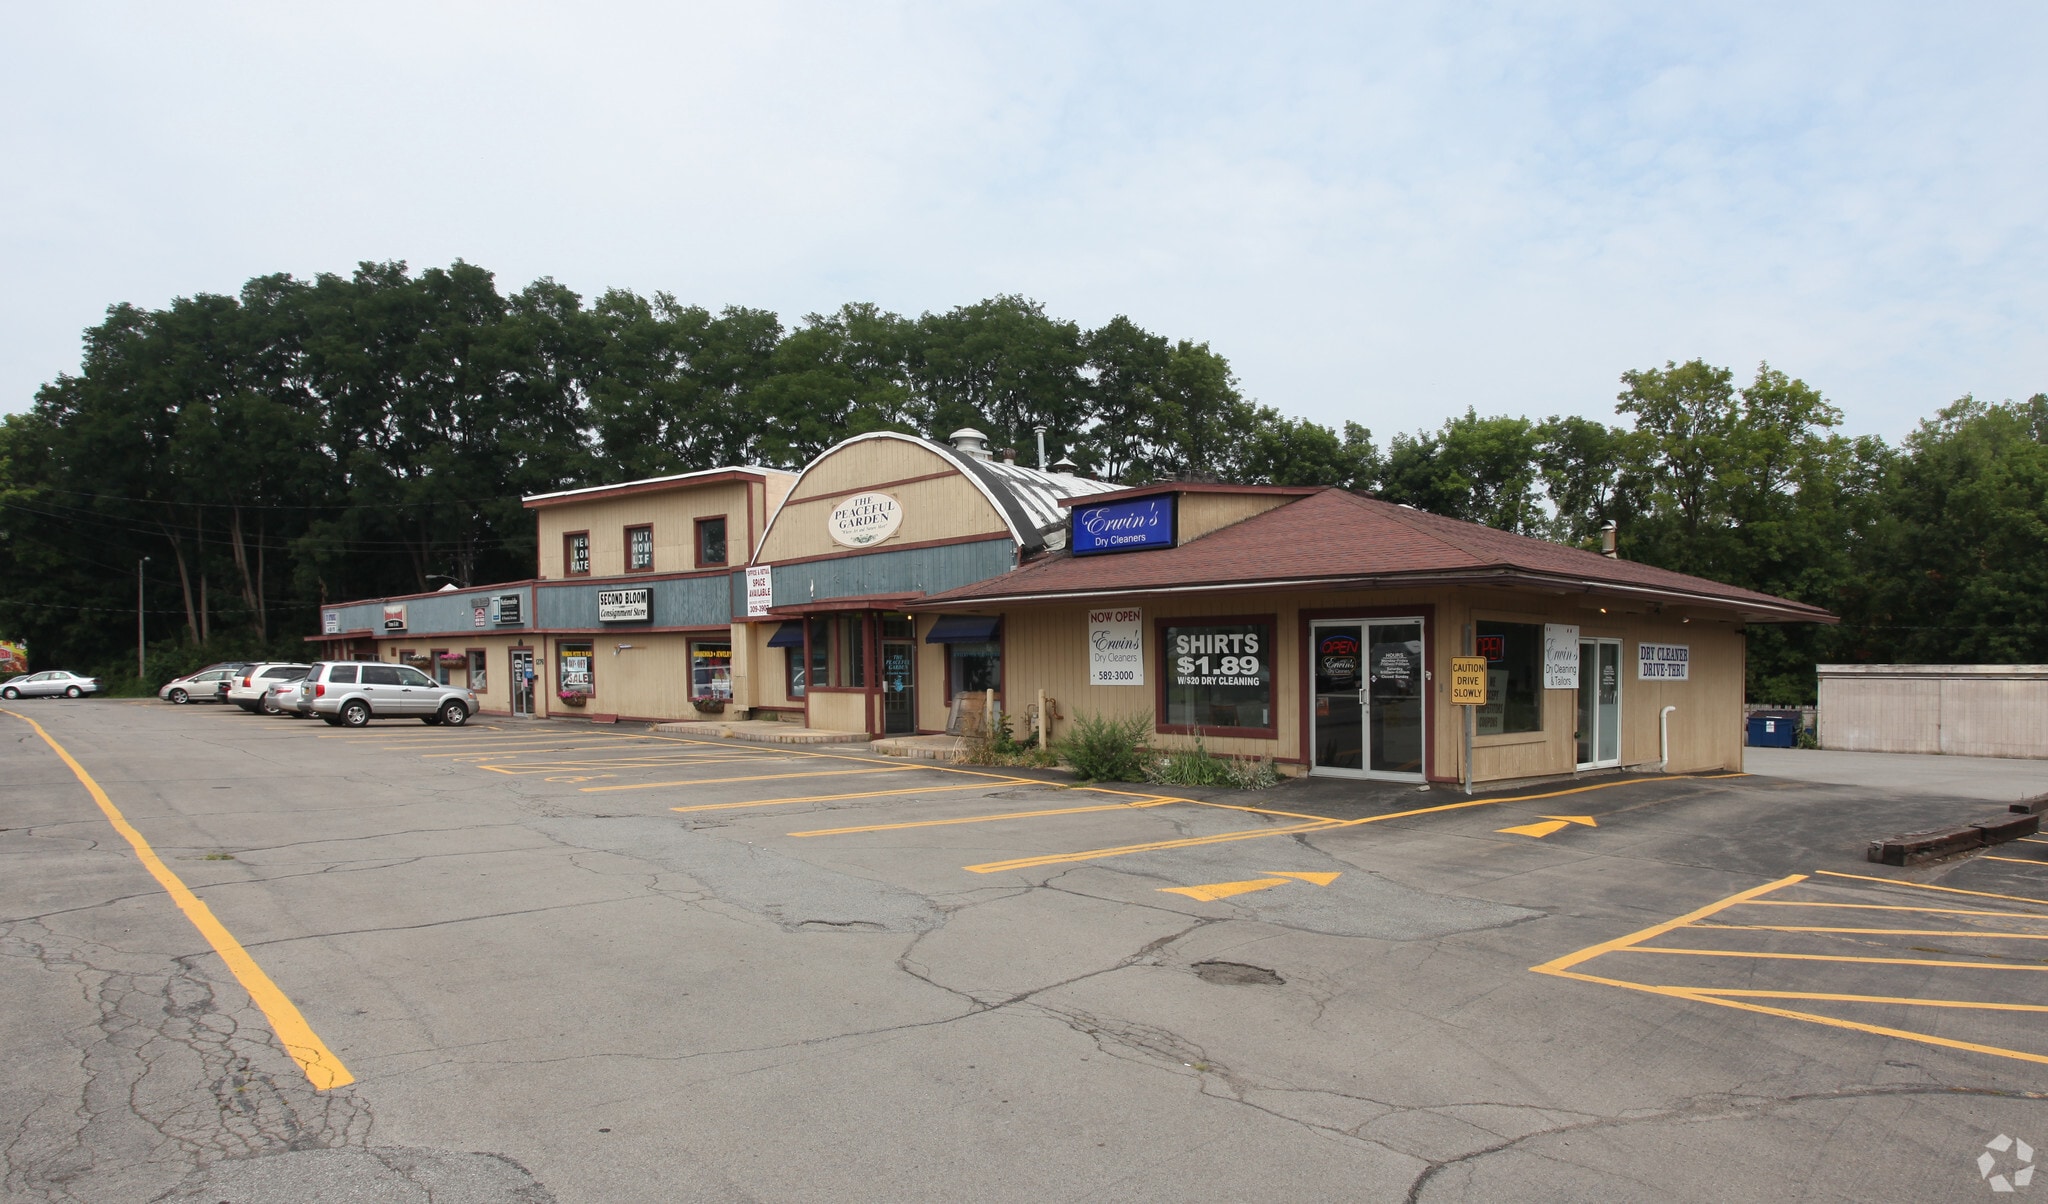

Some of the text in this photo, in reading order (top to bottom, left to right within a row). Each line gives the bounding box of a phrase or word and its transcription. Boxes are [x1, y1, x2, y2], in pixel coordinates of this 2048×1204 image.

[854, 496, 873, 506] THE
[835, 501, 895, 520] PEACEFUL
[839, 512, 889, 529] GARDEN
[1081, 501, 1159, 536] Erwin's
[632, 531, 652, 542] AUT
[1095, 534, 1146, 547] Dry Cleaners
[632, 553, 652, 564] LIF
[752, 578, 766, 587] SPACE
[600, 591, 647, 605] SECOND BLOOM
[749, 588, 771, 597] AVAILABLE
[600, 607, 647, 619] Consignment Store
[1090, 610, 1140, 623] NOW OPEN
[1091, 629, 1140, 652] Erwin's
[1176, 633, 1259, 655] SHIRTS
[1321, 640, 1359, 654] OPEN
[1094, 652, 1138, 664] Dry Cleaners
[1640, 646, 1688, 662] DRY CLEANER
[1176, 655, 1260, 675] $1.89
[1452, 663, 1484, 673] CAUTION
[1546, 663, 1577, 676] Dry Cleaning
[1643, 662, 1686, 677] DRIVE-THRU
[568, 674, 588, 683] SALE
[1098, 670, 1134, 680] 582-3000
[1177, 676, 1260, 686] W/$20 DRY CLEANING
[1457, 676, 1479, 686] DRIVE
[1555, 675, 1572, 686] Tailors
[1453, 688, 1482, 698] SLOWLY
